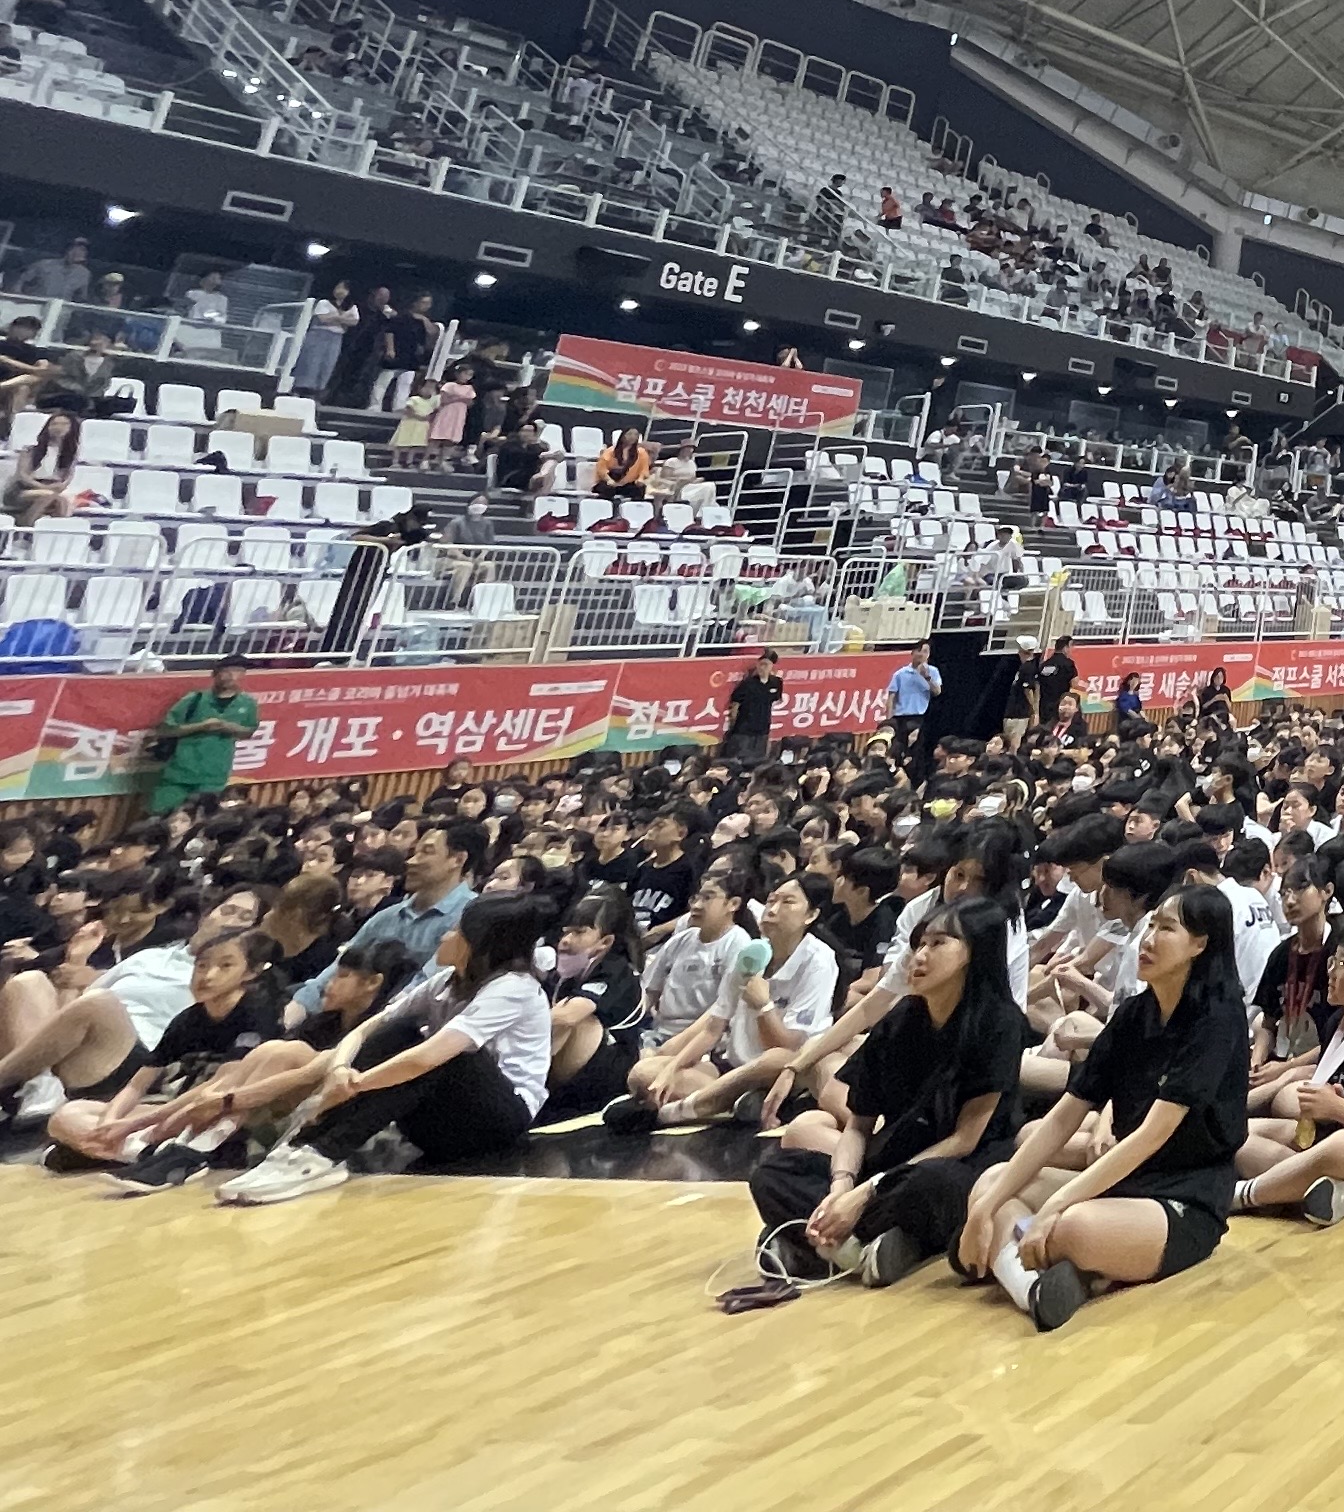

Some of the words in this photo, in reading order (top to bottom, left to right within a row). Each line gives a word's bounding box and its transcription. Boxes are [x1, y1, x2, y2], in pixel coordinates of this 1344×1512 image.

[660, 262, 719, 298] Gate
[724, 265, 750, 303] E
[615, 373, 716, 413] 점프스쿨
[720, 386, 810, 424] 천천센터
[1086, 672, 1156, 705] 점프쿨
[1271, 664, 1324, 691] 점프스쿨
[626, 697, 732, 741] 점프스
